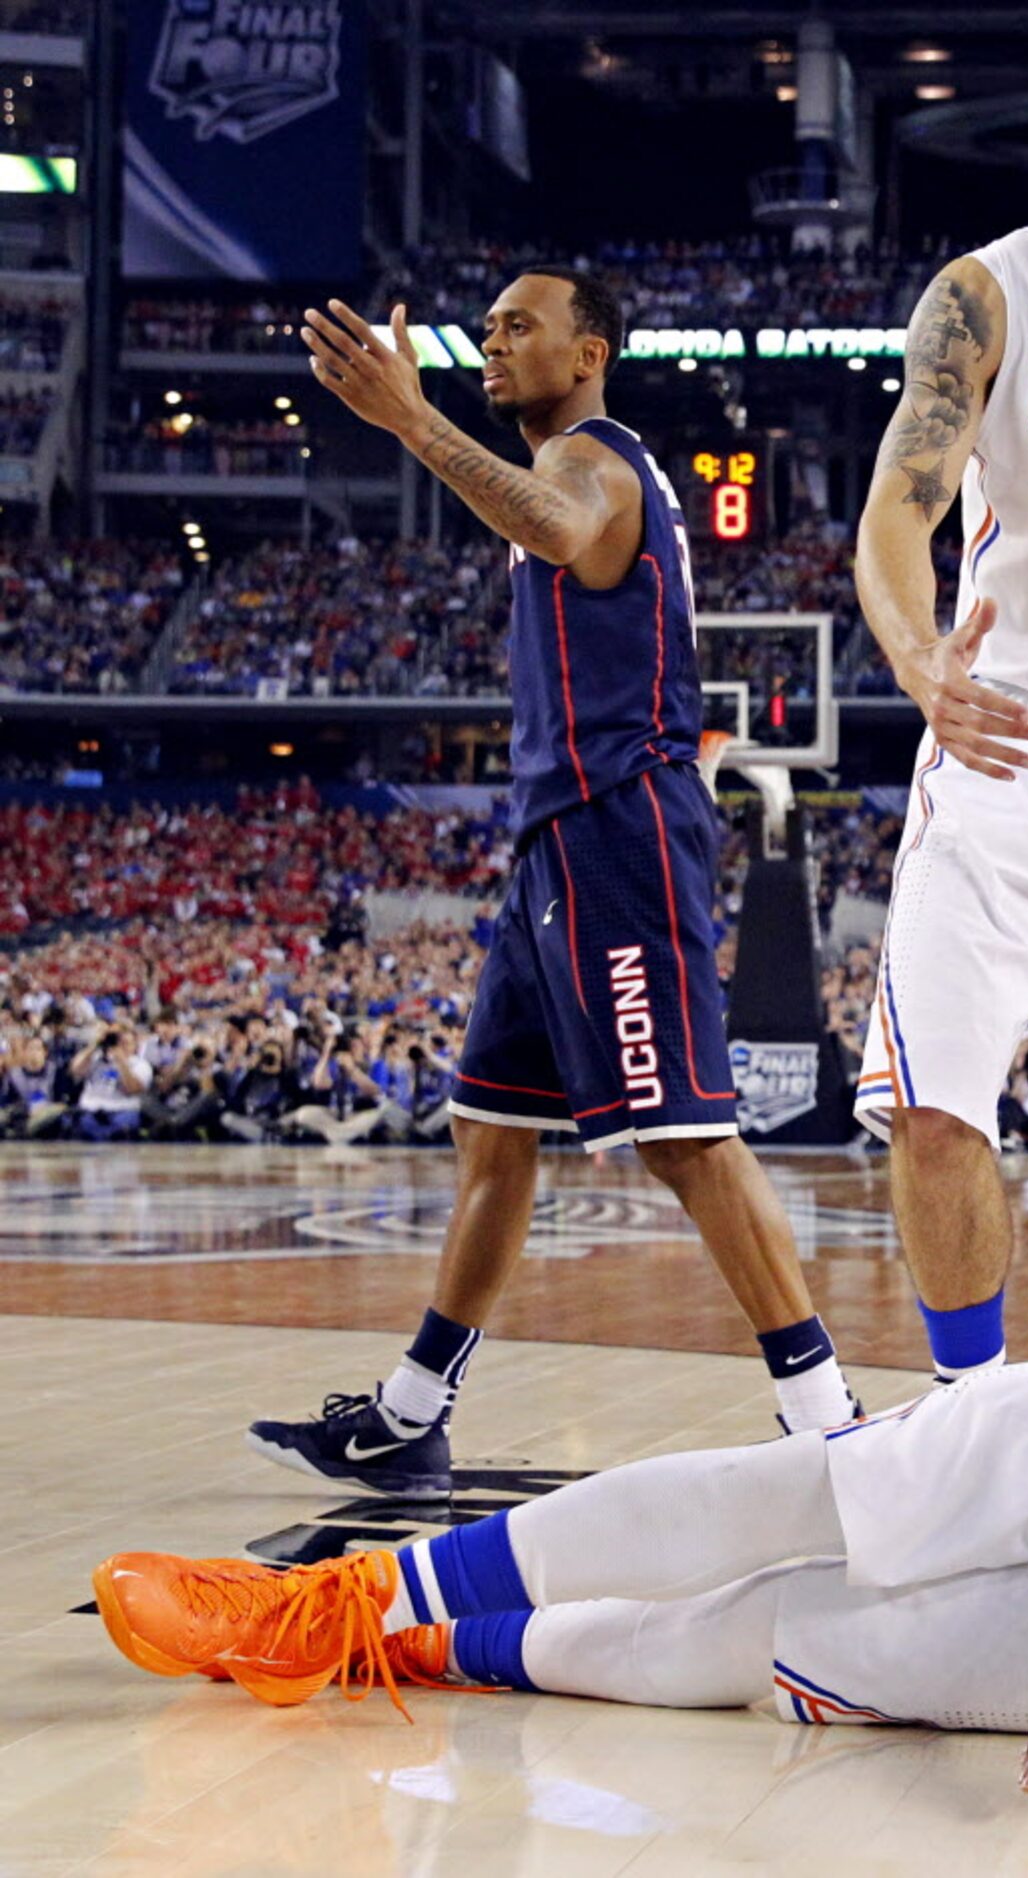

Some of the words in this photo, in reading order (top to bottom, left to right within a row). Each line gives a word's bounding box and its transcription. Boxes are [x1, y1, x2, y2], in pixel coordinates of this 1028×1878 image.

[693, 452, 756, 485] 9:12
[714, 484, 749, 538] 8
[606, 944, 664, 1111] UCONN
[751, 1051, 811, 1074] FINAL
